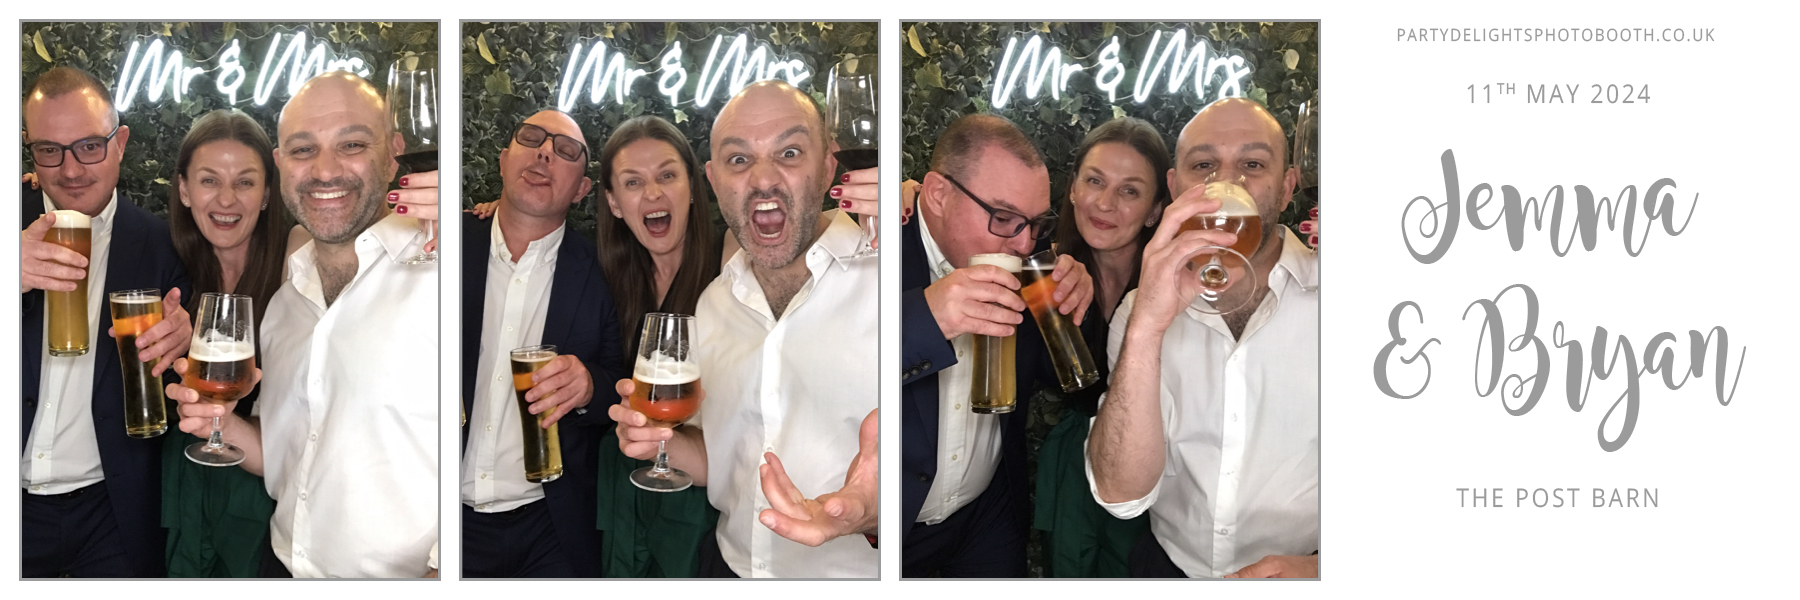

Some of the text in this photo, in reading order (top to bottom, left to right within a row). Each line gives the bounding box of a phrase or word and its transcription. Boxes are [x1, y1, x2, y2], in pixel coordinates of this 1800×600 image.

[115, 38, 205, 112] Mr
[216, 38, 246, 106] &
[557, 40, 645, 112] Mr
[658, 40, 686, 107] &
[992, 28, 1251, 108] Mr & Mrs
